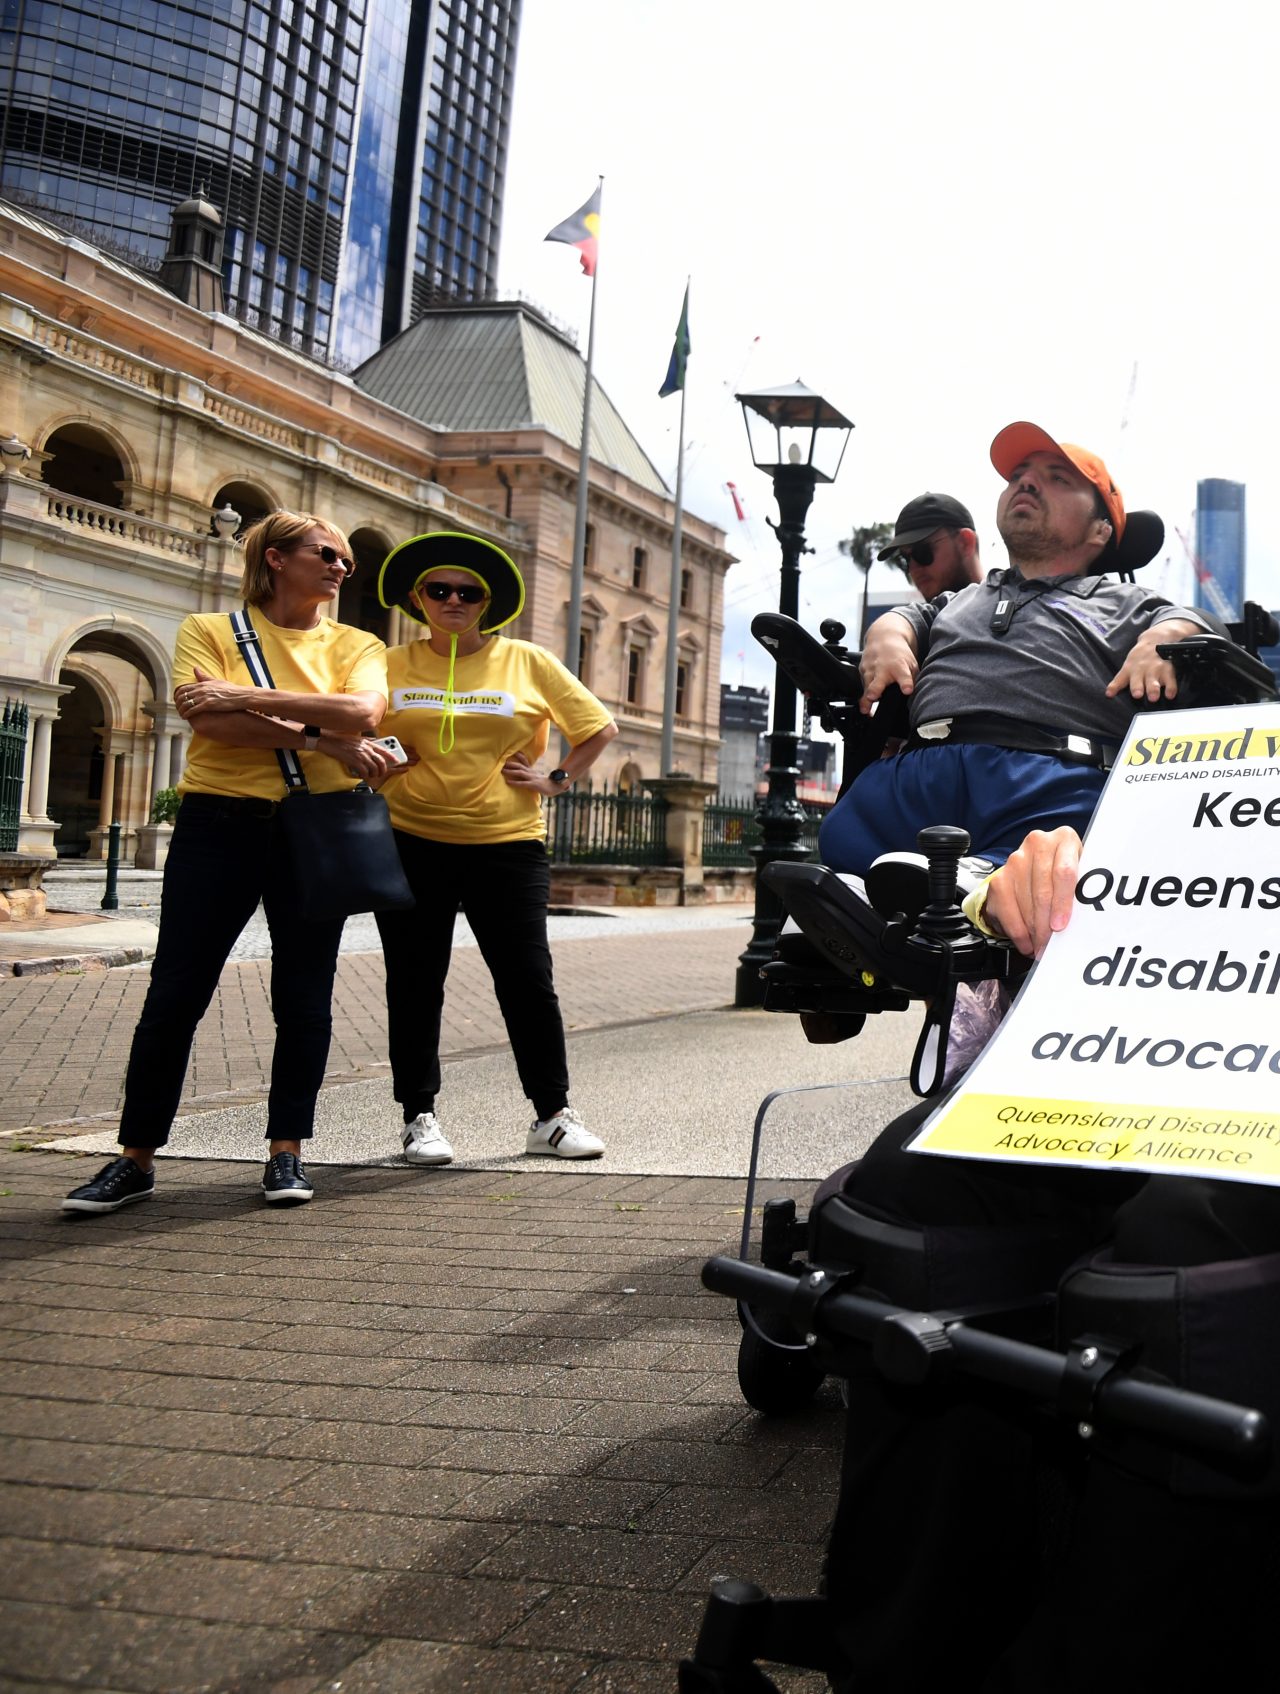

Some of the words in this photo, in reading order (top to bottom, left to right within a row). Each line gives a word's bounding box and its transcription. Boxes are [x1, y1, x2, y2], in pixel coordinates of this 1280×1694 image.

[404, 692, 443, 702] Stand
[481, 696, 502, 705] us!
[1127, 727, 1254, 767] Stand
[1124, 770, 1209, 784] QUEENSLAND
[996, 1105, 1156, 1132] Queensland
[995, 1133, 1130, 1160] Advocacy
[1134, 1141, 1254, 1165] Alliance
